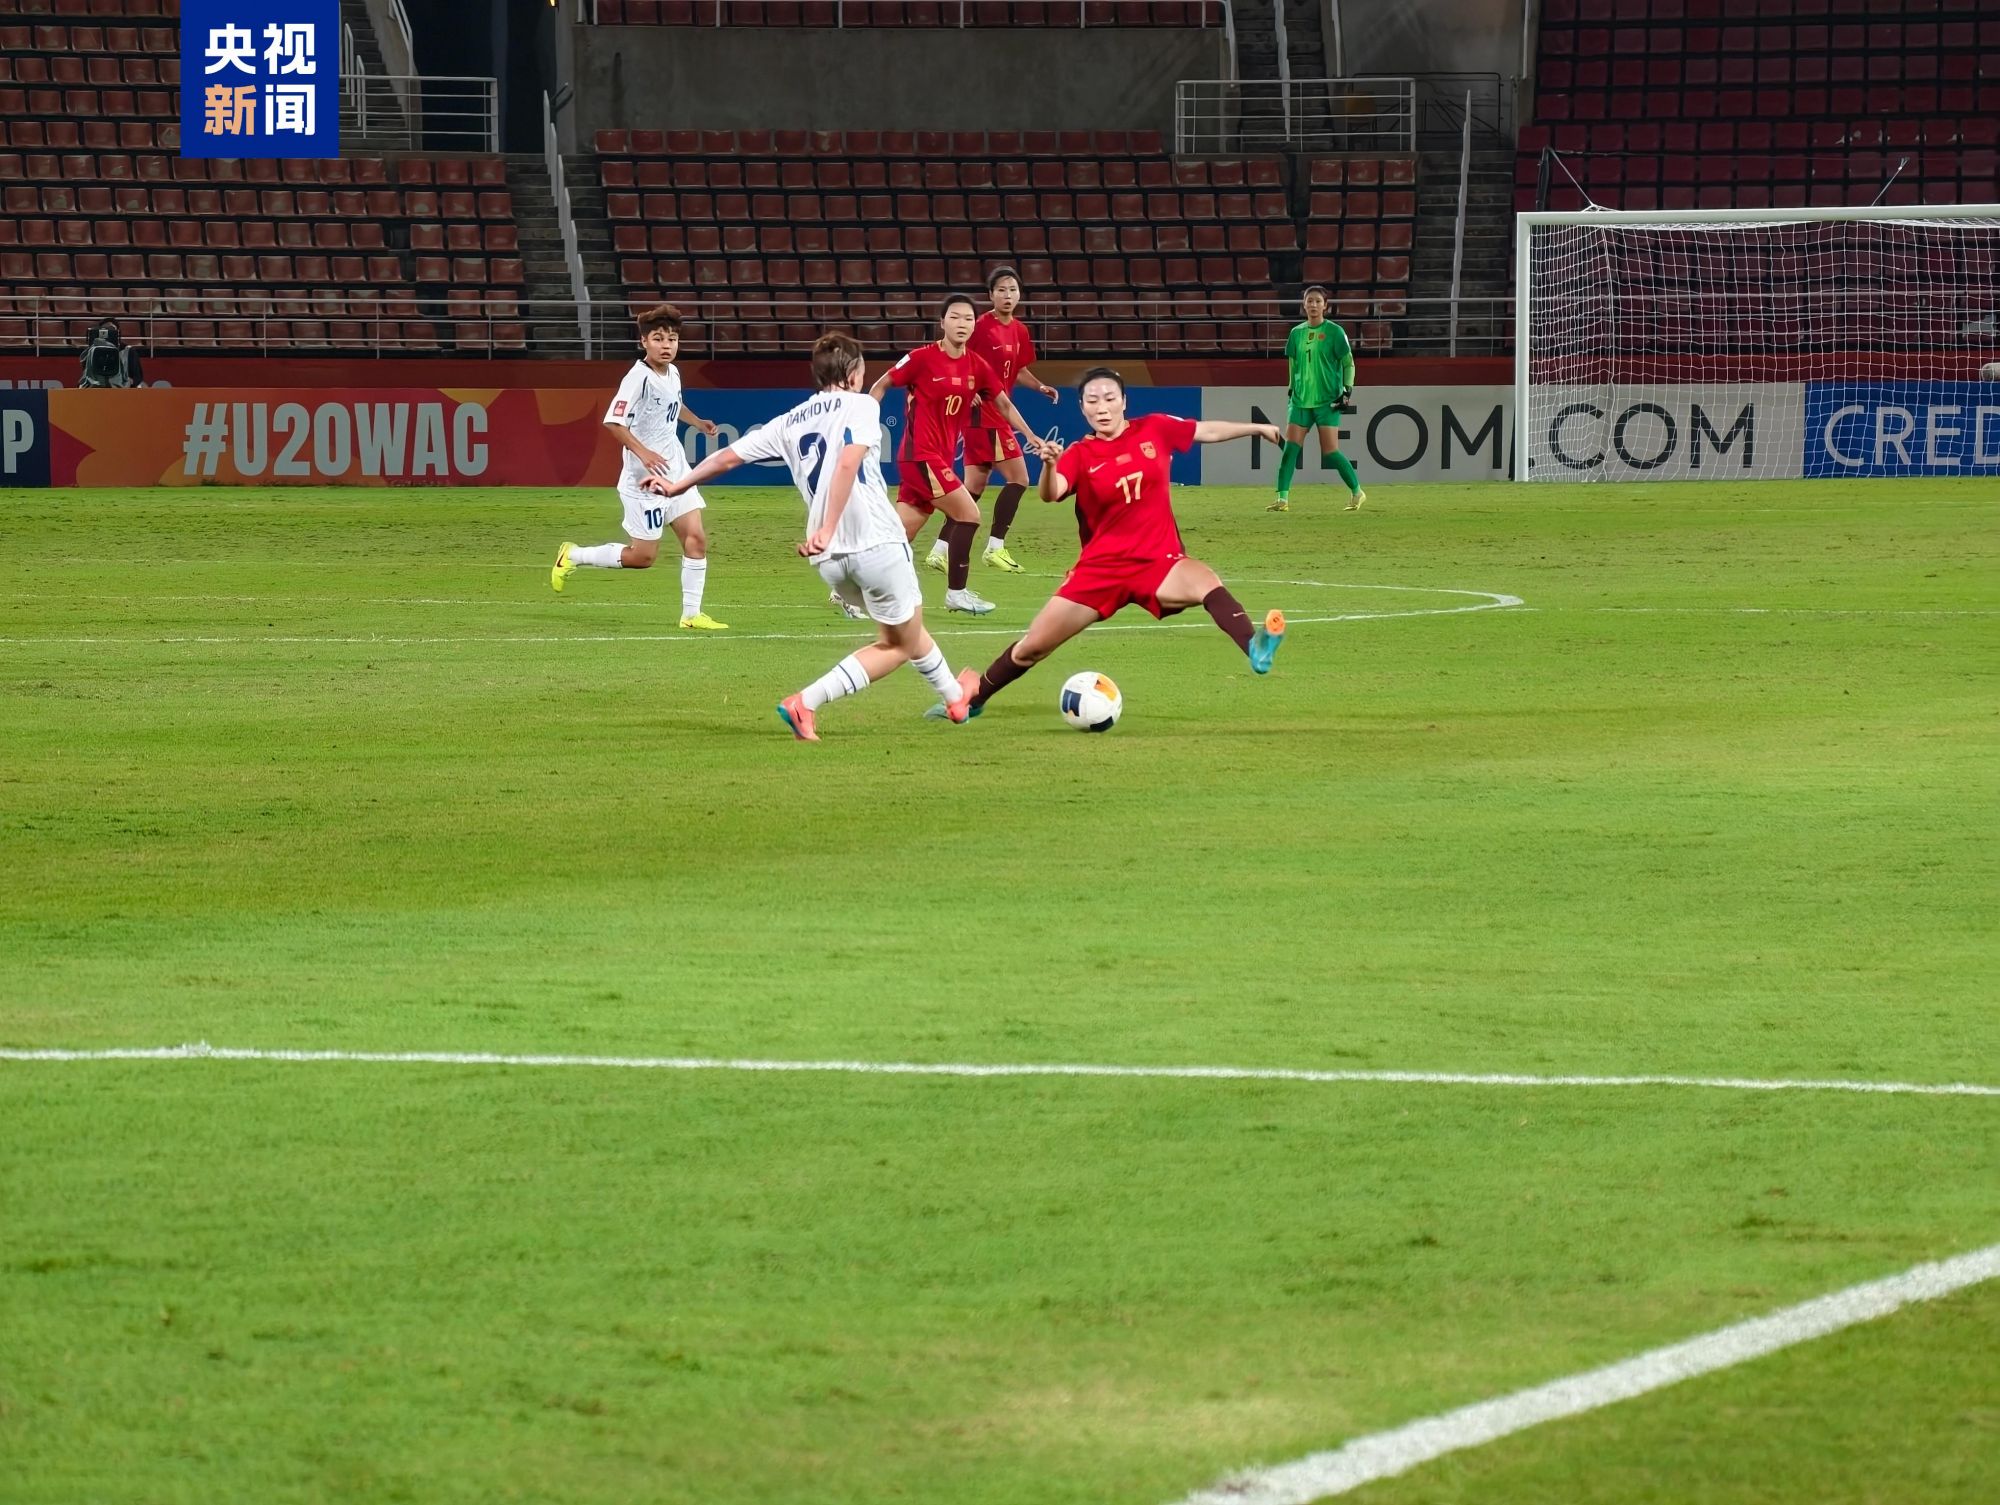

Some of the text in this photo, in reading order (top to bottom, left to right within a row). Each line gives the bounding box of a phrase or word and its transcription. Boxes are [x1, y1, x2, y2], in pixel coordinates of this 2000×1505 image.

[1306, 349, 1311, 363] 1
[1003, 360, 1011, 379] 3
[666, 401, 679, 423] 10
[945, 395, 962, 415] 10
[183, 402, 488, 476] #U20WAC
[1824, 405, 2000, 466] CRED
[797, 432, 827, 499] 2
[1115, 471, 1143, 504] 17
[644, 507, 662, 530] 10
